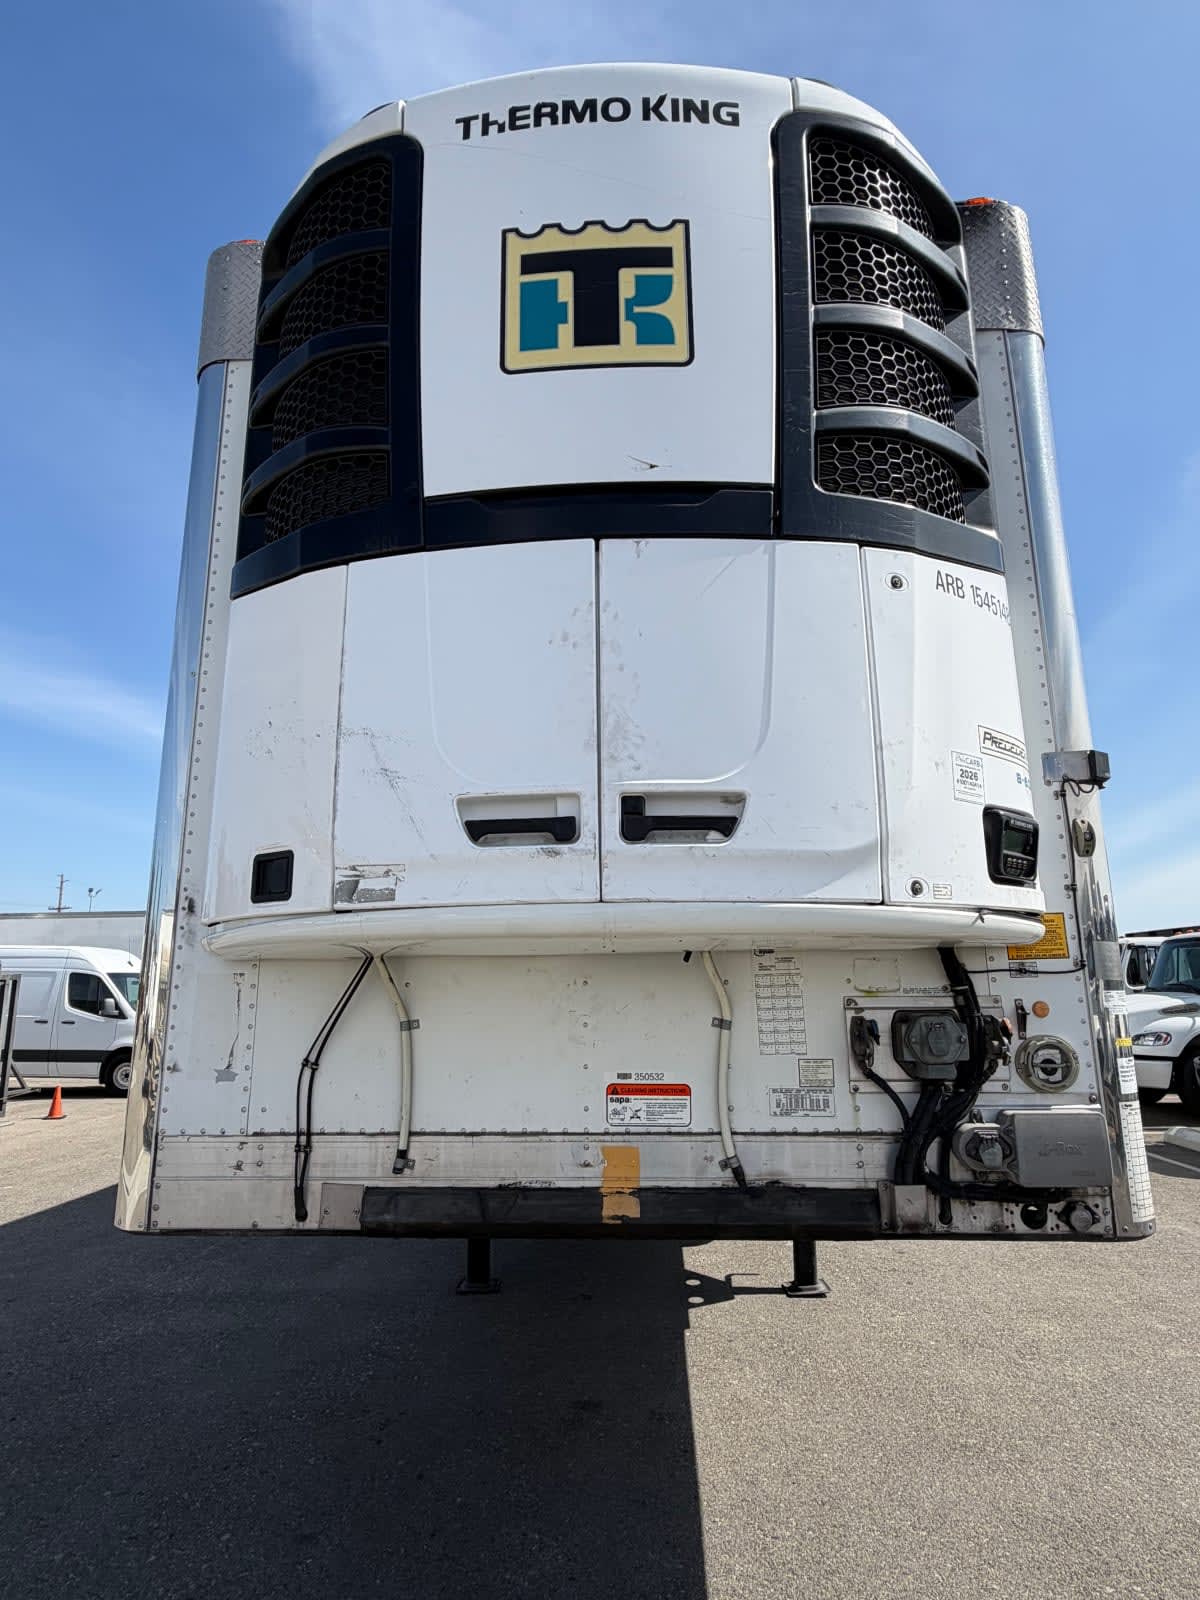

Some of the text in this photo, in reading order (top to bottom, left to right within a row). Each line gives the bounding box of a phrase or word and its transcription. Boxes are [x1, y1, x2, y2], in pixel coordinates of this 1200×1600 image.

[641, 93, 741, 127] KING
[935, 569, 966, 600] ARB
[959, 768, 979, 782] 2026
[634, 1072, 665, 1081] 350532
